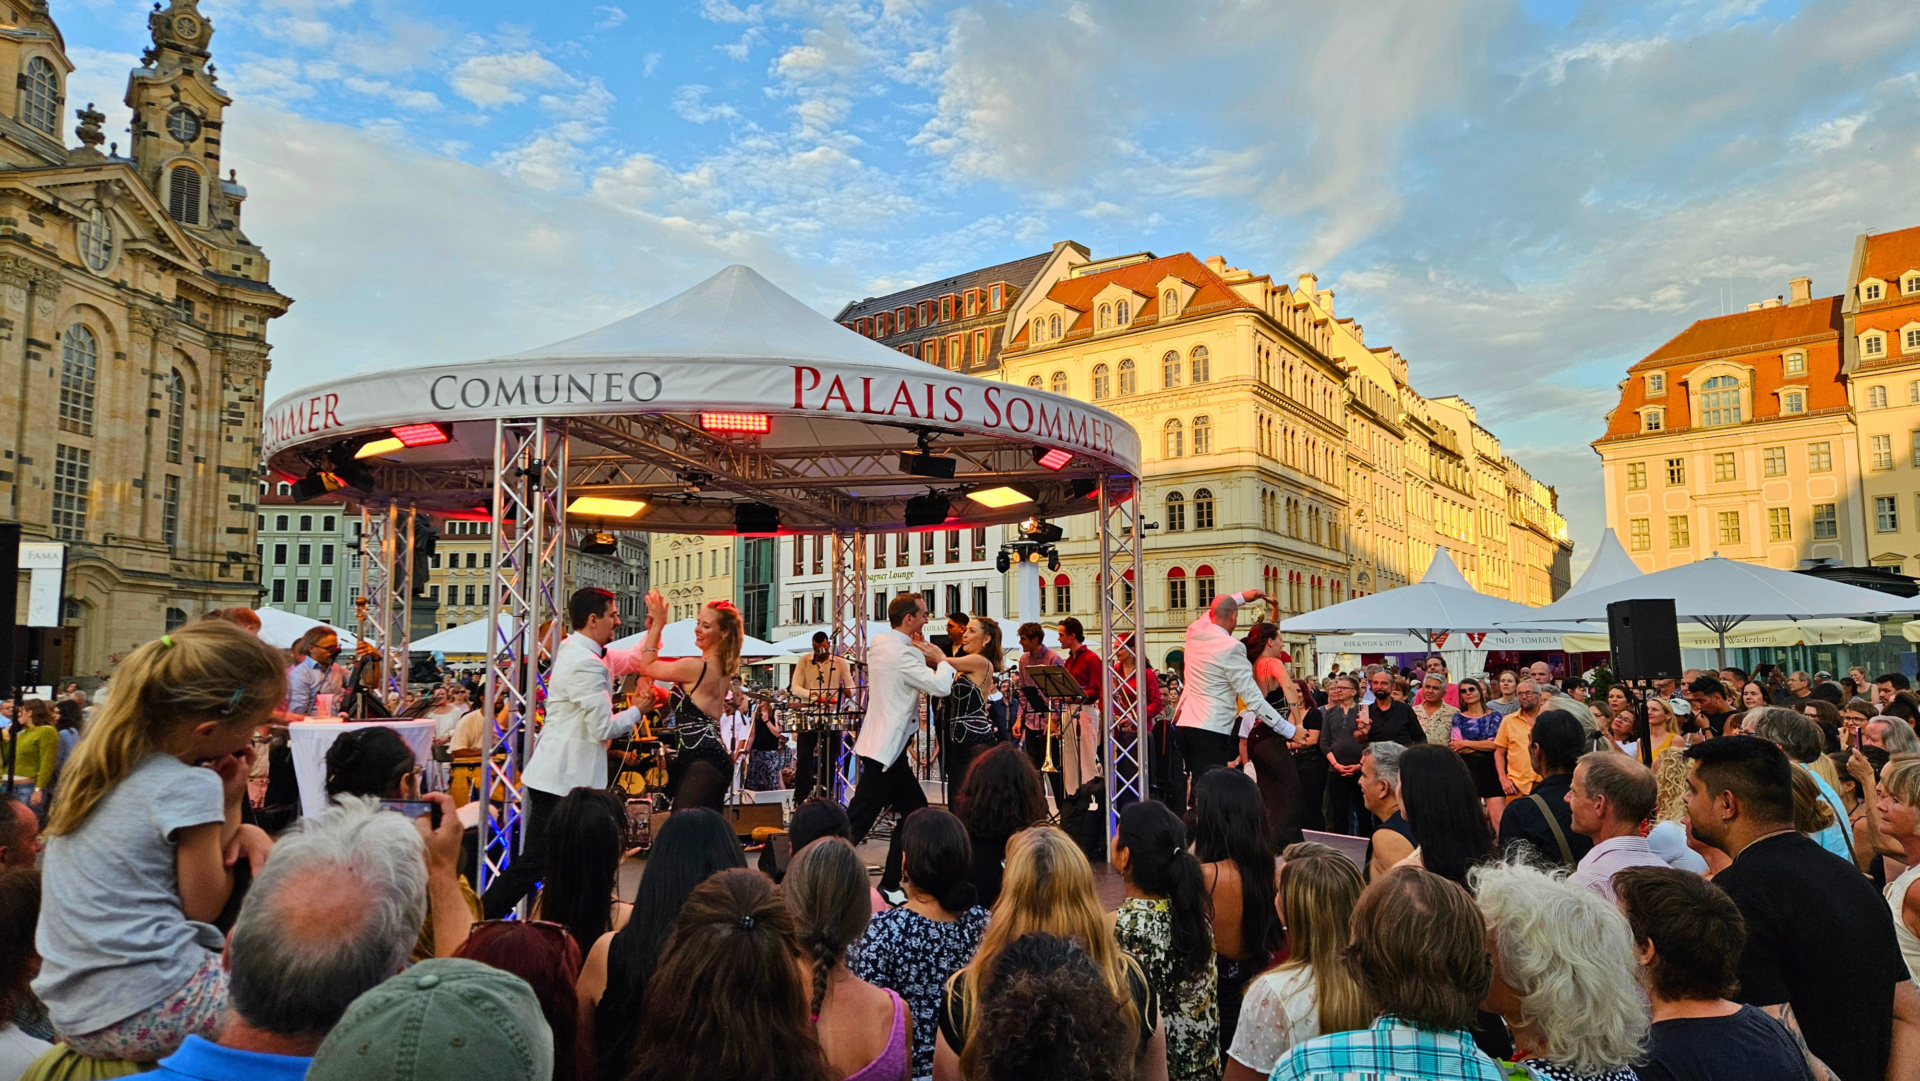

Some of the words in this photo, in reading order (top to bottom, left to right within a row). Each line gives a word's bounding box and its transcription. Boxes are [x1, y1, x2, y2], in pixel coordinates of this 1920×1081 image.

[430, 371, 662, 410] COMUNEO
[790, 365, 964, 423] PALAIS
[983, 386, 1116, 457] SOMMER
[1133, 404, 1161, 415] ALLES
[1167, 396, 1210, 410] GELEGEN
[263, 393, 345, 457] OMMER
[28, 550, 59, 560] FAMA
[888, 570, 915, 581] Lounge
[1520, 636, 1558, 644] TOMBOLA
[1725, 635, 1777, 644] Wackerbarth
